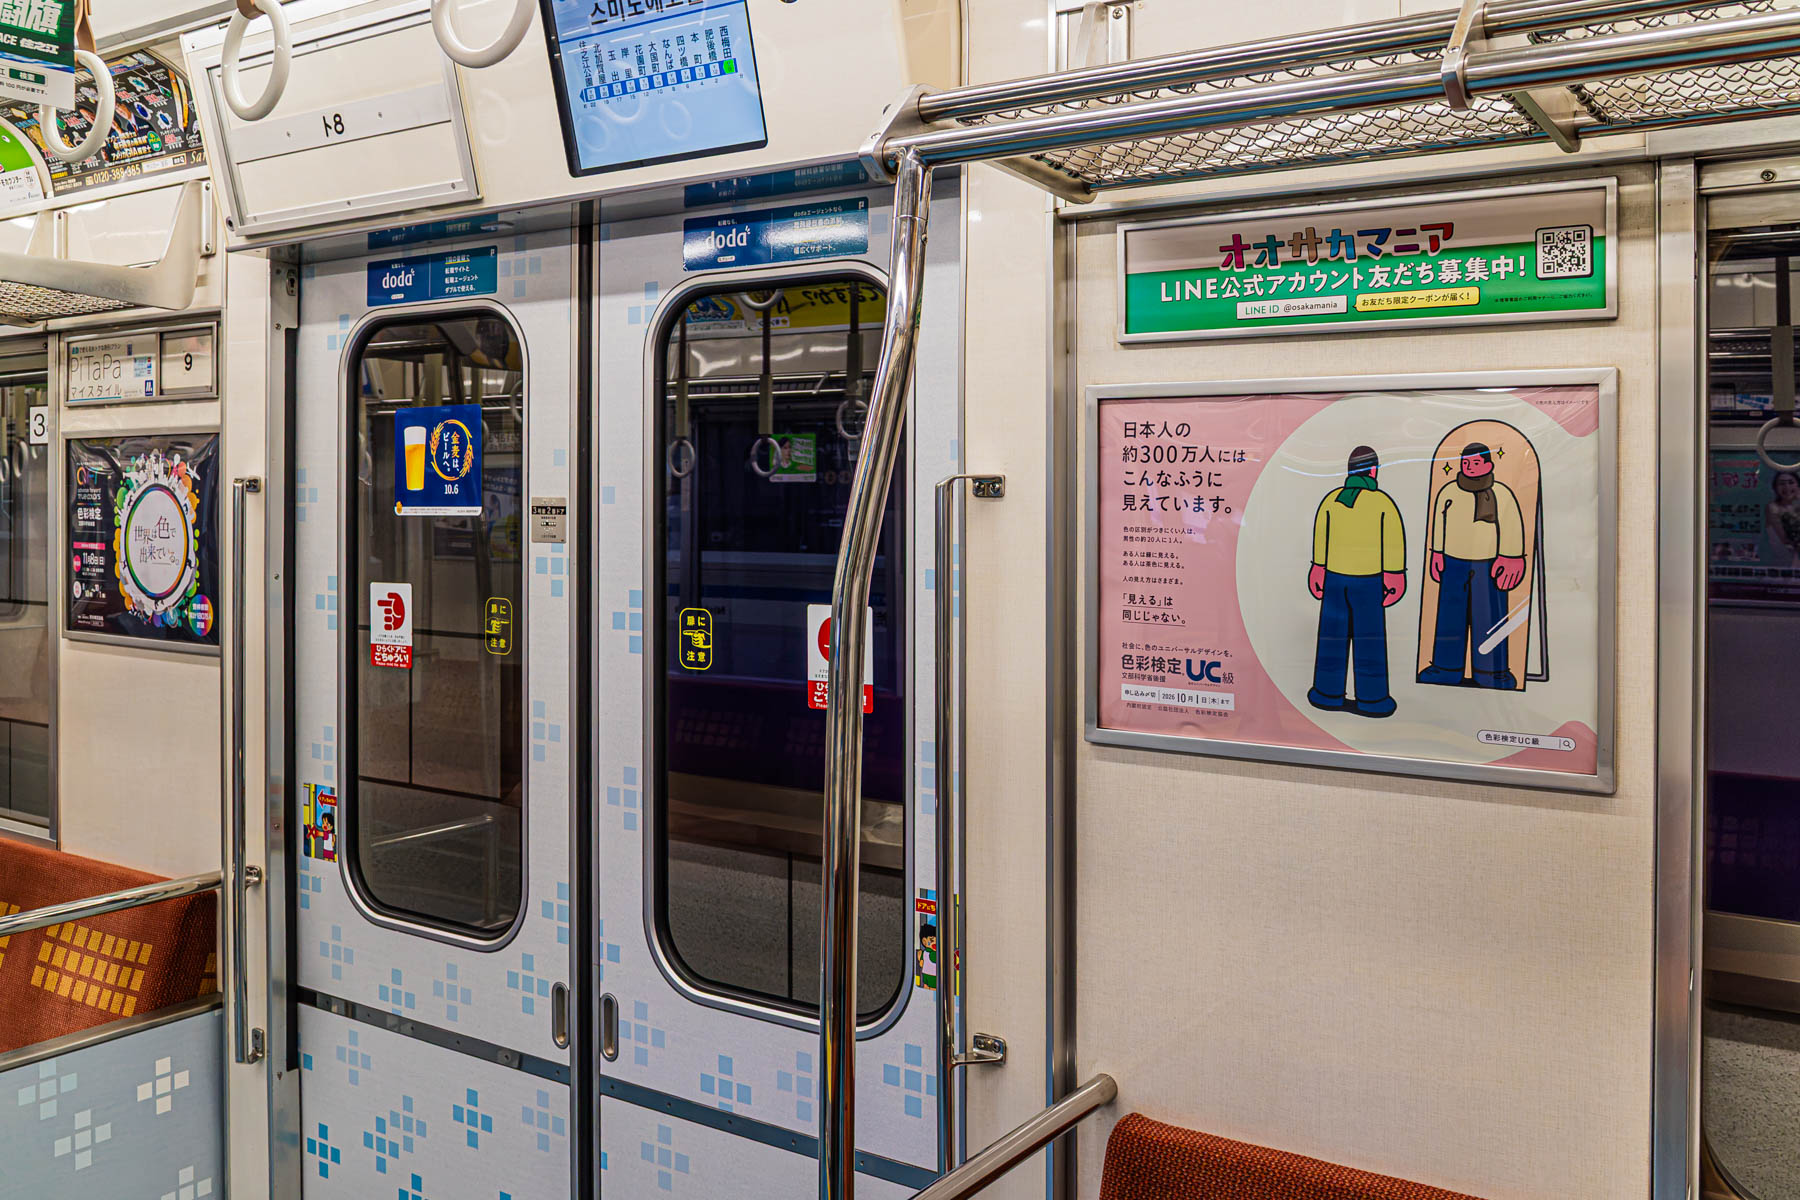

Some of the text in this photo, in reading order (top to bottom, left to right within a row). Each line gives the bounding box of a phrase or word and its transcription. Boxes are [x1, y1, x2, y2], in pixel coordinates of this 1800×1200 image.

[704, 29, 717, 61] 肥後橋
[719, 25, 732, 58] 西梅田
[634, 44, 647, 75] 花園町
[648, 41, 660, 73] 大国町
[662, 39, 674, 70] なんば
[676, 35, 689, 67] 四ツ橋
[706, 227, 747, 249] doda
[1219, 222, 1454, 269] オオサカマニア
[382, 269, 413, 289] doda
[1245, 301, 1338, 316] LINE ID @osakamania
[70, 353, 122, 382] PiTaPa
[184, 353, 192, 371] 9
[71, 384, 122, 398] マイスタイル
[34, 413, 45, 437] 3
[1124, 421, 1191, 439] 日本人の
[451, 431, 460, 472] 金麦は、
[1122, 445, 1246, 464] 約300万人には
[1123, 470, 1223, 488] こんなふうに
[444, 484, 459, 495] 10.6
[1122, 494, 1232, 514] 見えています。
[134, 515, 176, 544] 世界は色で
[1123, 526, 1197, 536] 色の区別がつきにくい人は、
[1123, 536, 1183, 544] 男性の約20人に1人。
[139, 543, 180, 566] 出来ている。
[1122, 550, 1179, 560] ある人は緑に見える。
[1122, 560, 1185, 570] ある人は茶色に見える。
[1122, 576, 1184, 586] 人の見え方はさまざま。
[1122, 592, 1174, 607] 「見える」は
[1122, 609, 1186, 625] 同じじゃない。
[376, 644, 407, 654] ひらくドアに
[686, 650, 706, 663] 注意
[1122, 642, 1233, 658] 社会に、色のユニバーサルデザインを。
[1122, 654, 1182, 676] 色彩検定
[1124, 689, 1156, 698] 申し込み〆切
[1484, 733, 1540, 746] 色彩検定UC級
